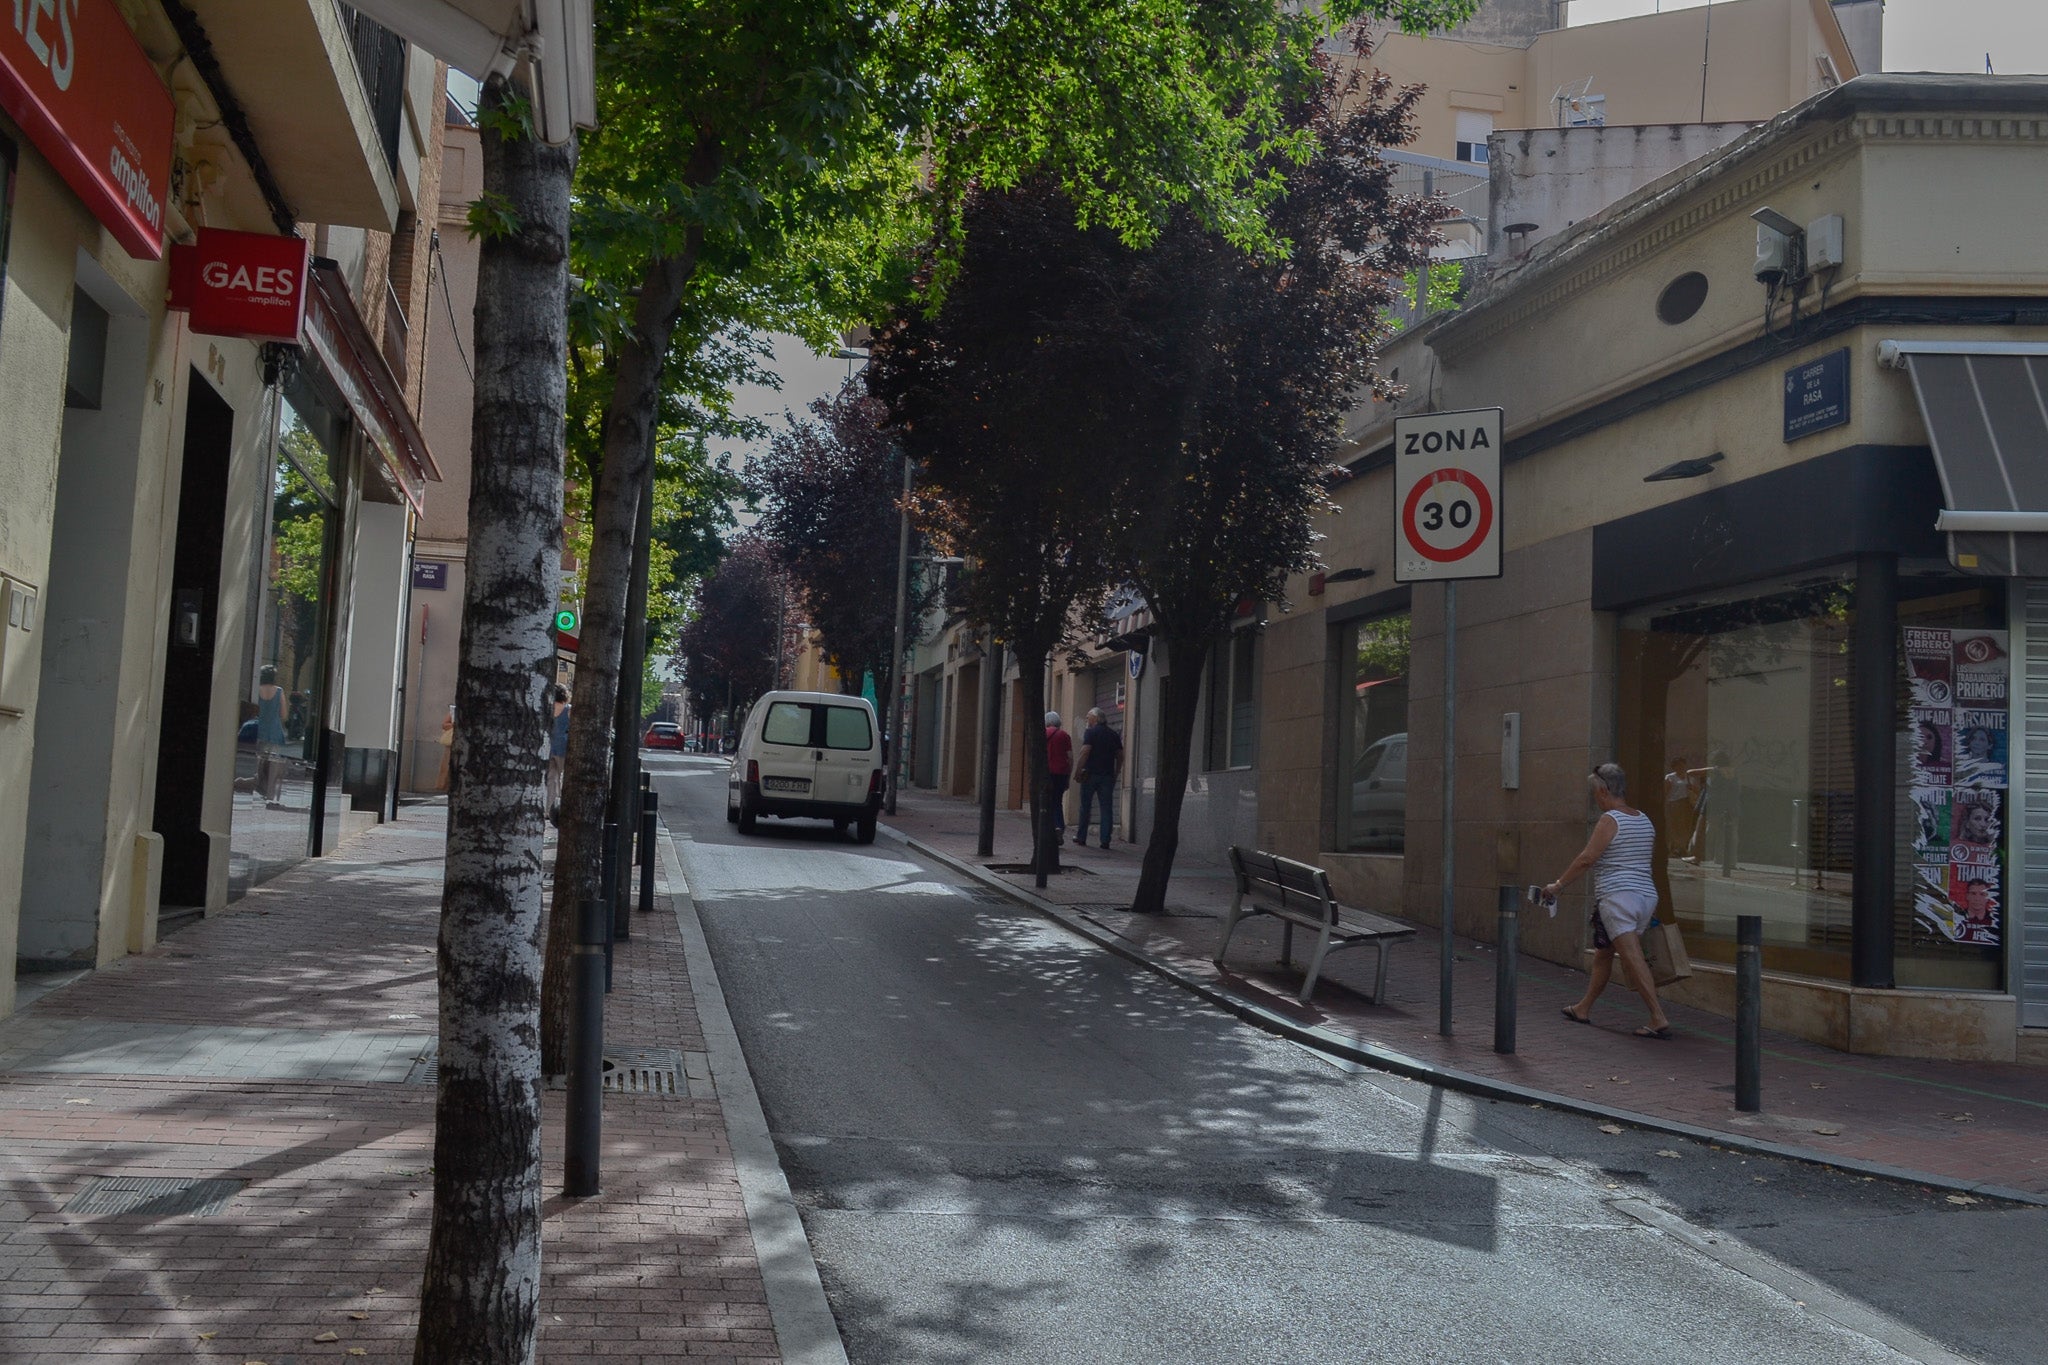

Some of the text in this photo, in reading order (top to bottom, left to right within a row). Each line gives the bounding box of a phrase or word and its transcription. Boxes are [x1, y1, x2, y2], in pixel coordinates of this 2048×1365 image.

[110, 146, 160, 231] amplifon
[202, 261, 294, 296] GAES
[247, 296, 291, 307] amplifon
[1802, 364, 1824, 380] CARRER
[1803, 390, 1823, 406] RASA
[1405, 427, 1490, 455] ZONA
[1423, 500, 1472, 530] 30
[1907, 630, 1949, 641] FRENTE
[1905, 640, 1951, 650] OBRERO
[1956, 665, 1969, 673] LOS
[1956, 672, 2006, 684] TRABAJADORES
[1956, 683, 2005, 699] PRIMERO
